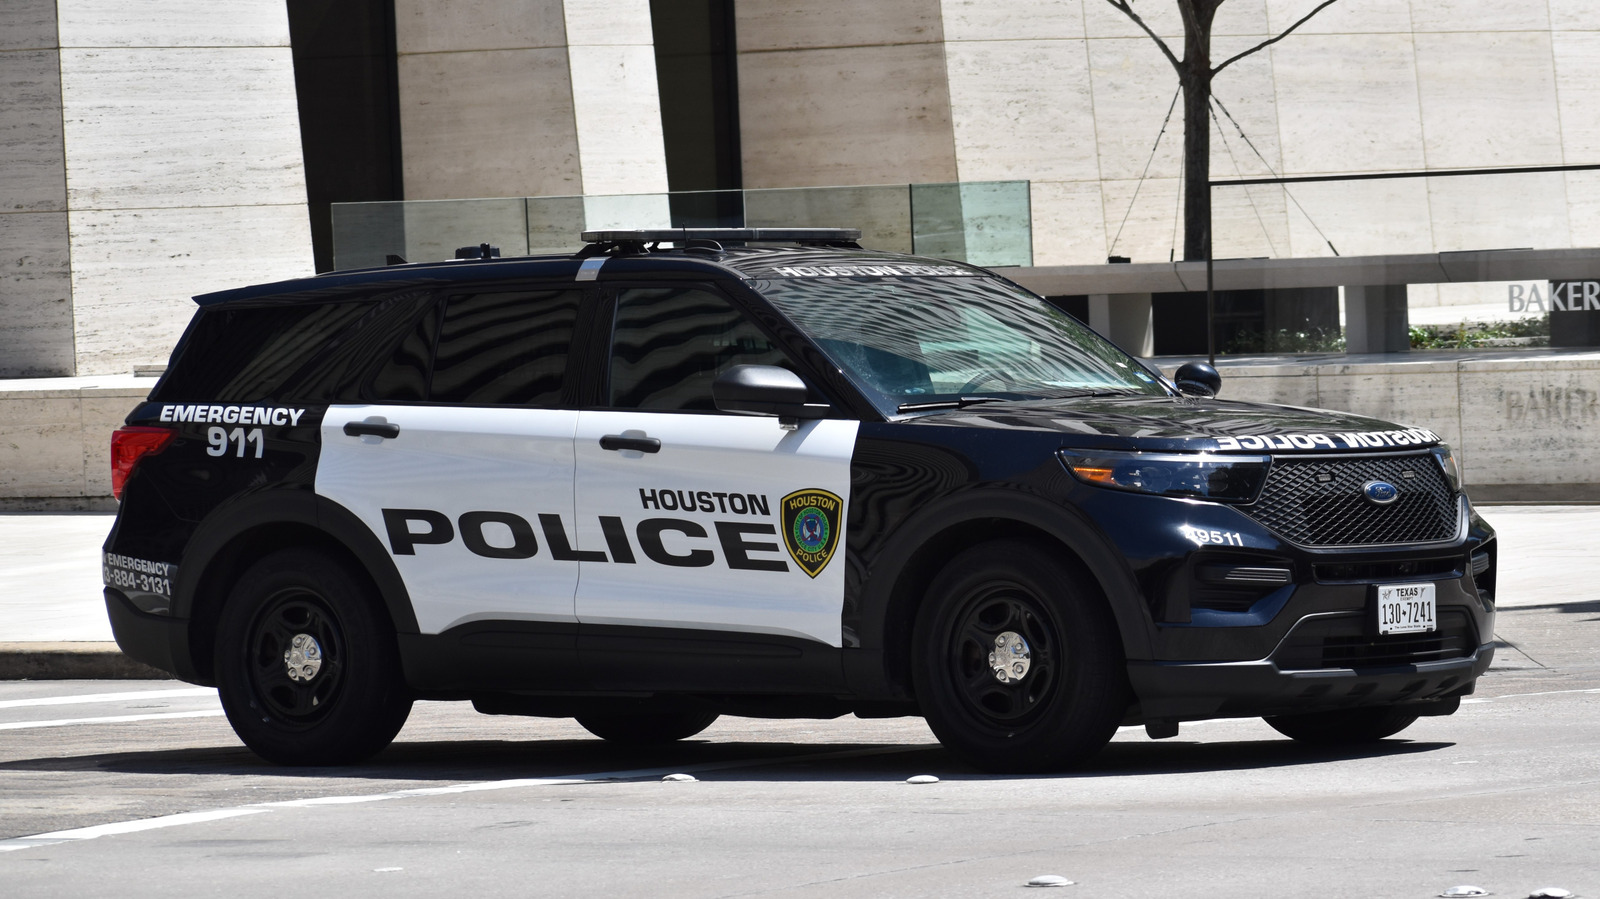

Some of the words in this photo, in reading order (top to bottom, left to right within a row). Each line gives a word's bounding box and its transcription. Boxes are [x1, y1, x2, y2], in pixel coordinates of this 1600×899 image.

[772, 266, 903, 277] HOUSTON
[1508, 281, 1600, 313] BAKER
[160, 405, 305, 426] EMERGENCY
[206, 426, 264, 459] 911
[639, 488, 771, 516] HOUSTON
[789, 496, 836, 511] HOUSTON
[381, 508, 790, 572] POLICE
[107, 552, 169, 576] EMERGENCY
[796, 548, 828, 562] POLICE
[1396, 587, 1418, 597] TEXAS
